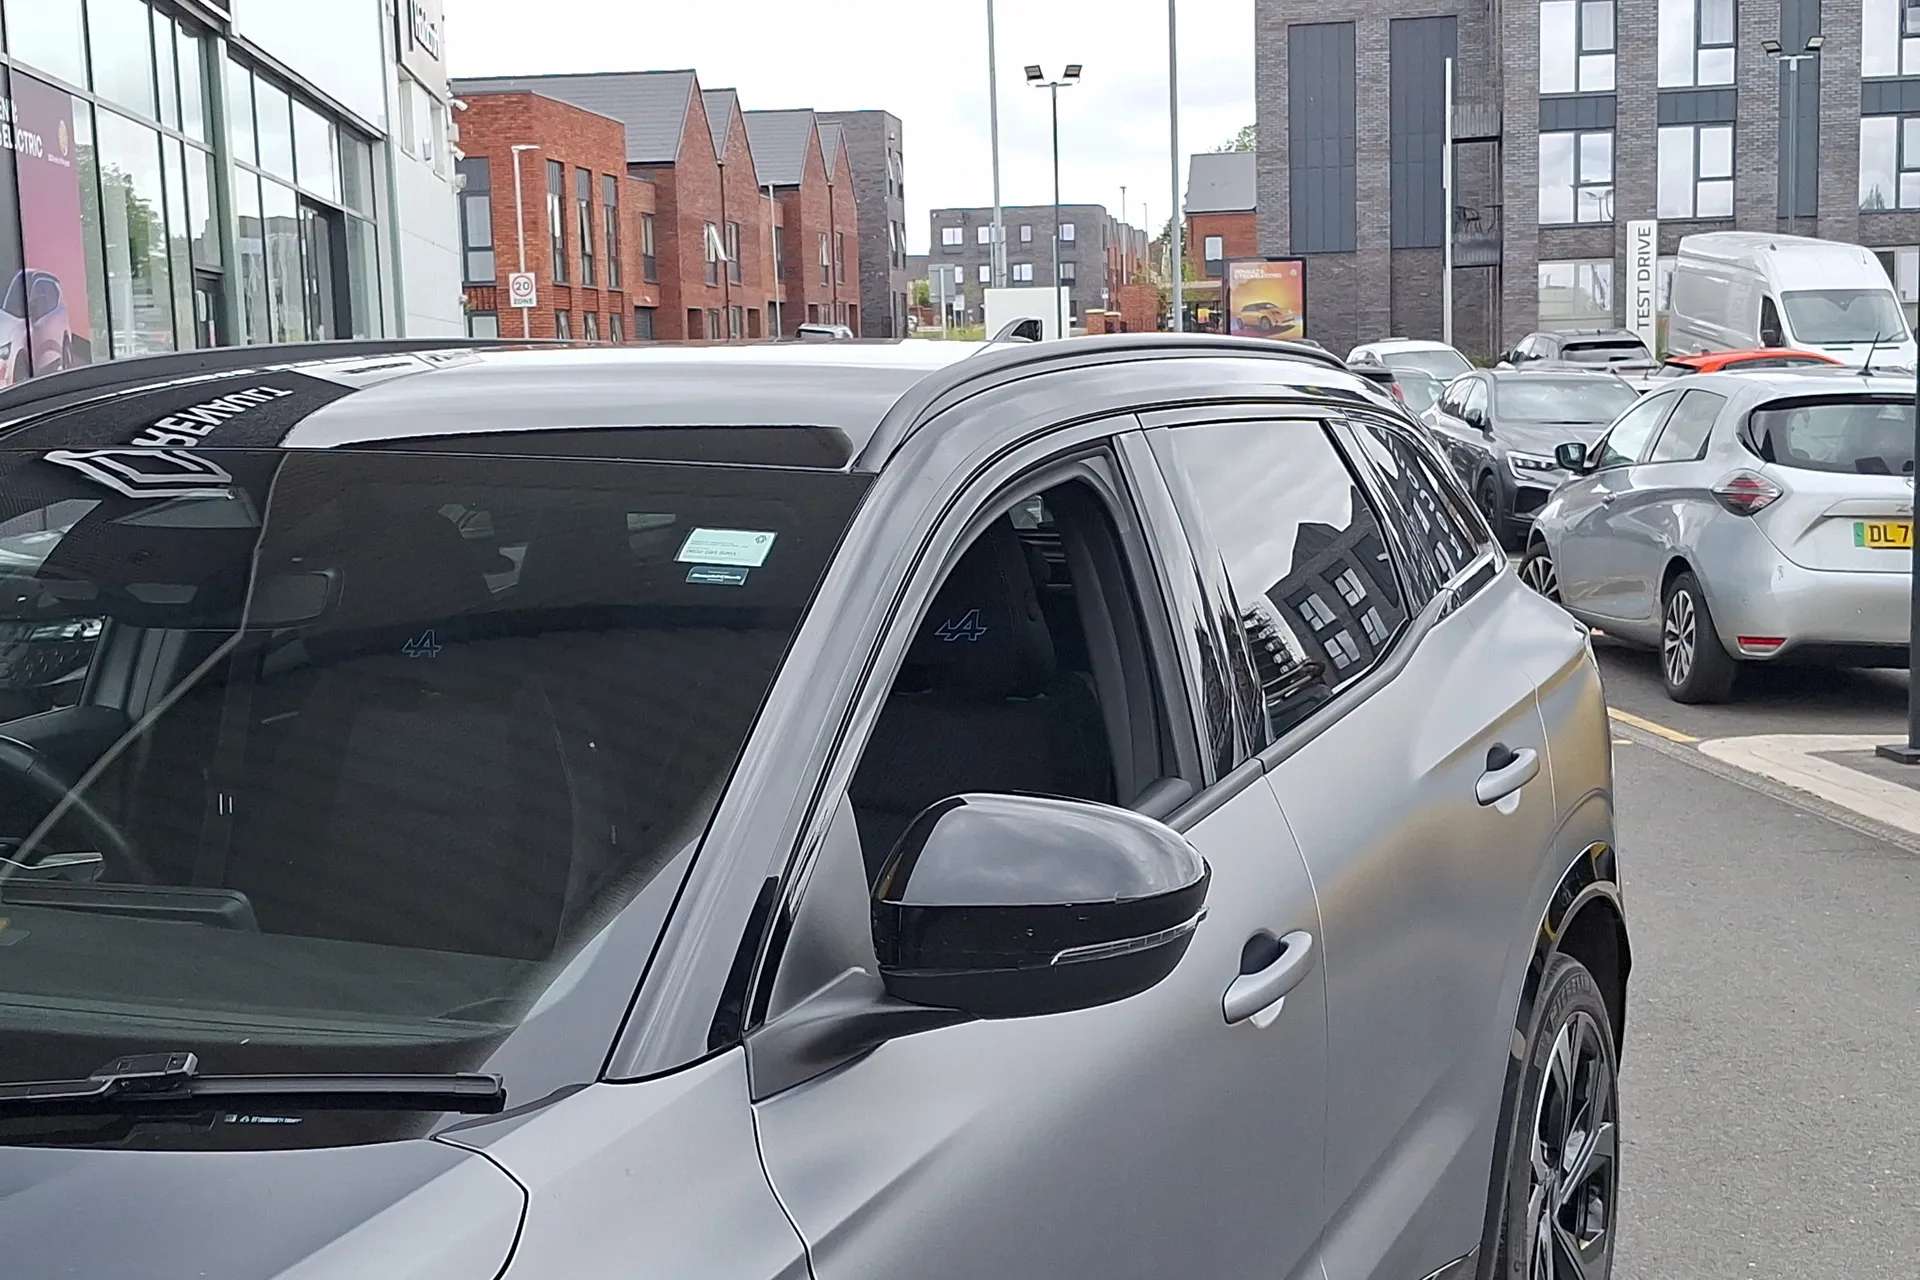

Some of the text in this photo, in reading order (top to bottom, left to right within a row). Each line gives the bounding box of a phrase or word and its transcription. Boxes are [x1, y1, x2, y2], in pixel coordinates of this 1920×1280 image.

[2, 123, 43, 158] ELCTRIC
[515, 281, 530, 291] 20
[1637, 226, 1651, 330] TEST DRIVE
